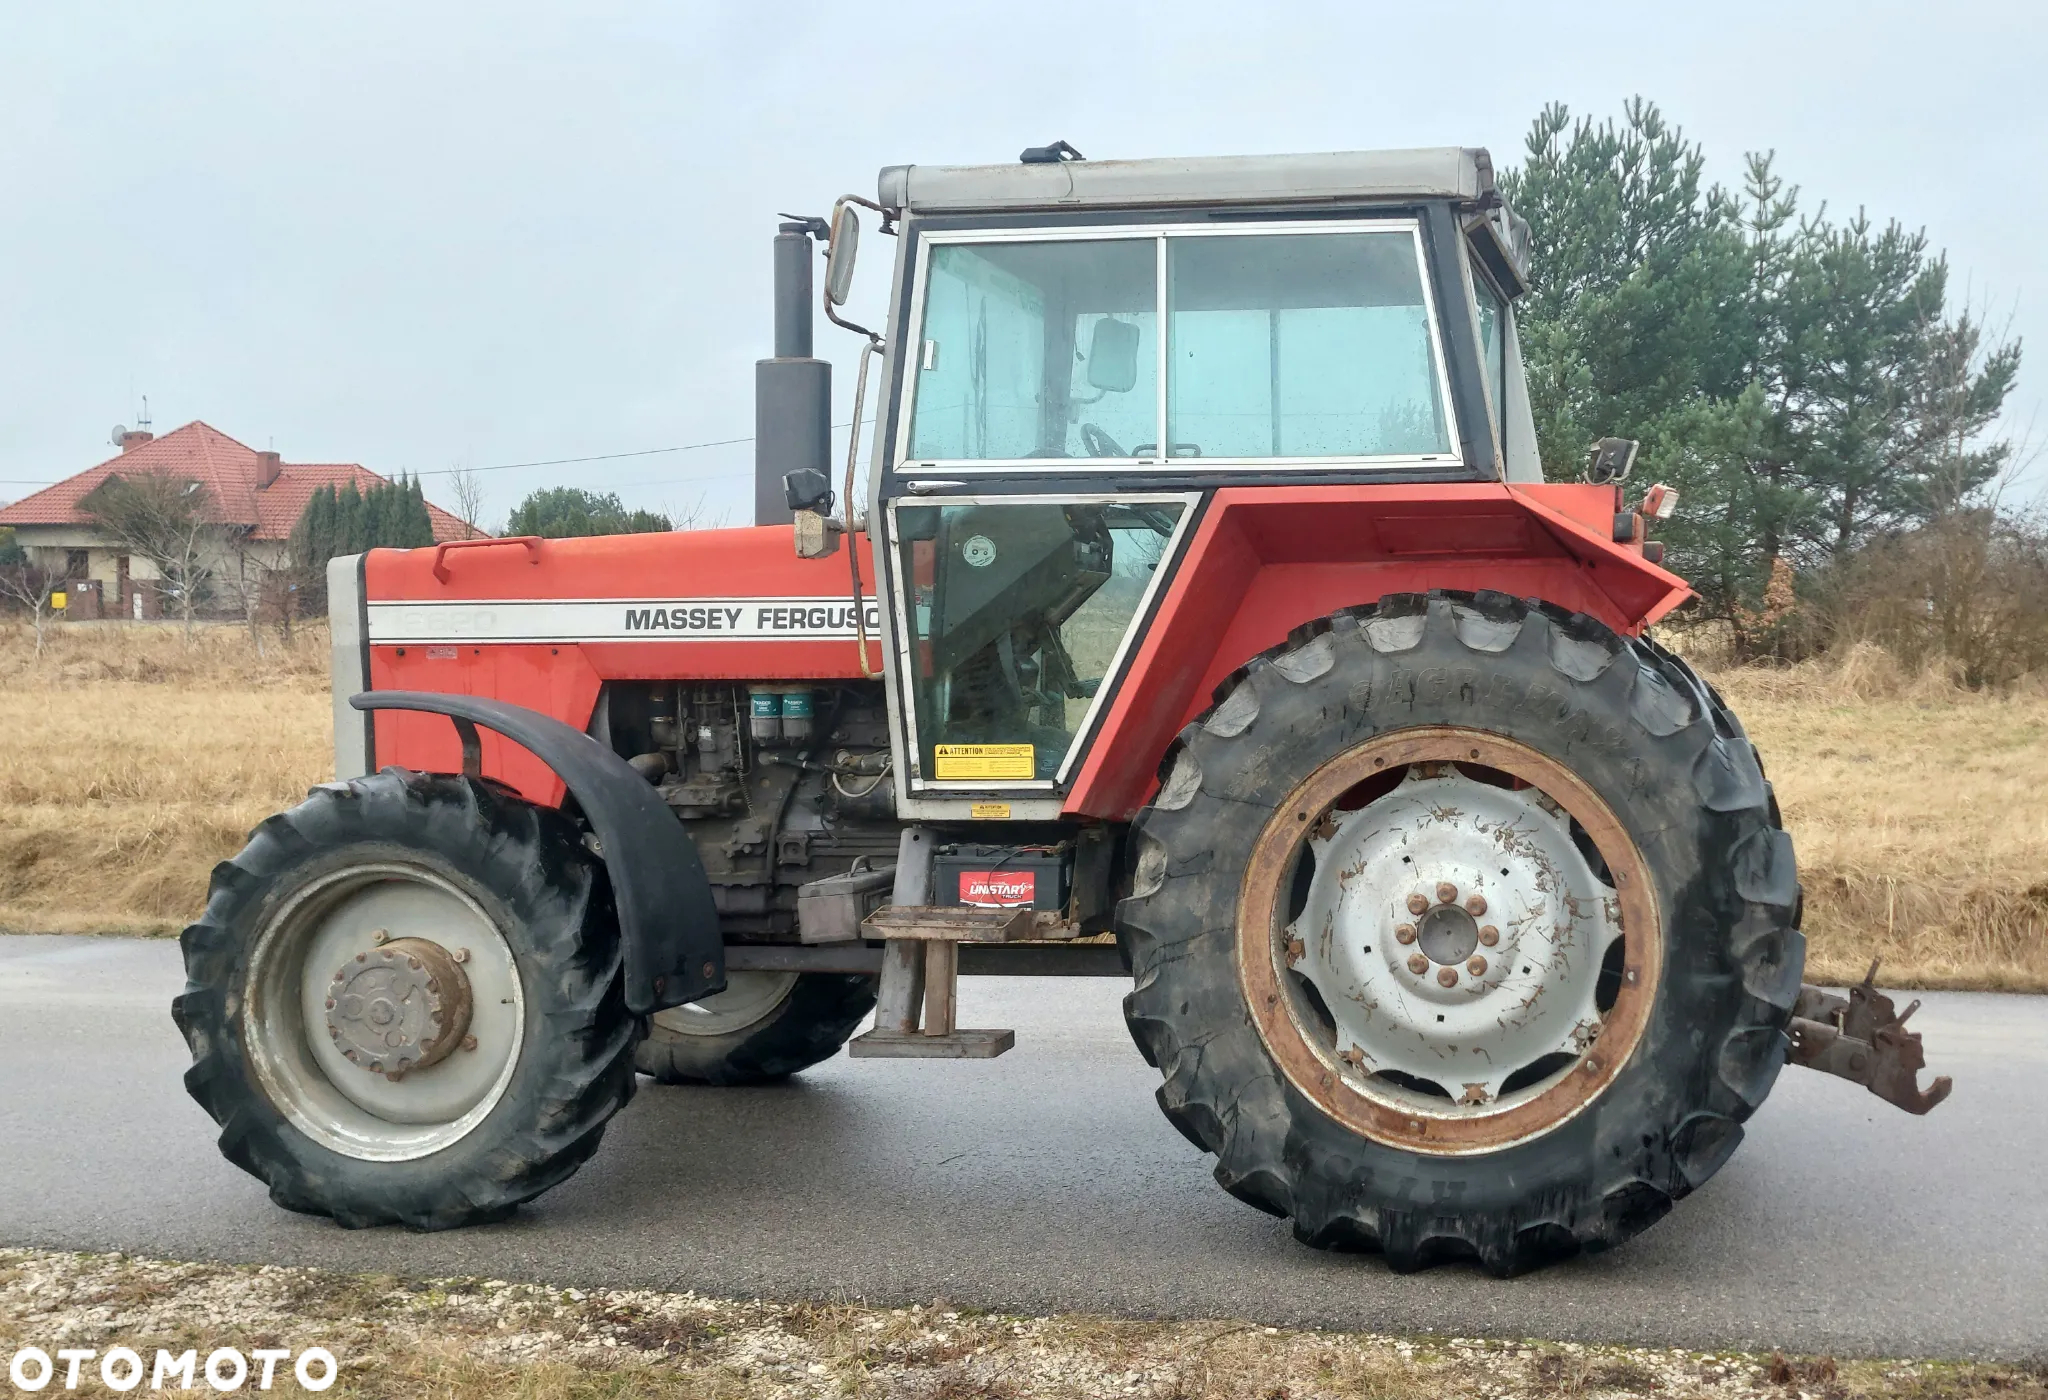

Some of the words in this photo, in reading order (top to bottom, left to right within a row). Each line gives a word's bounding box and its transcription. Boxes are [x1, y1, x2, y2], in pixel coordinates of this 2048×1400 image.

[625, 608, 743, 630] MASSEY
[949, 747, 984, 755] ATTENTION
[970, 884, 1026, 895] UNISTART
